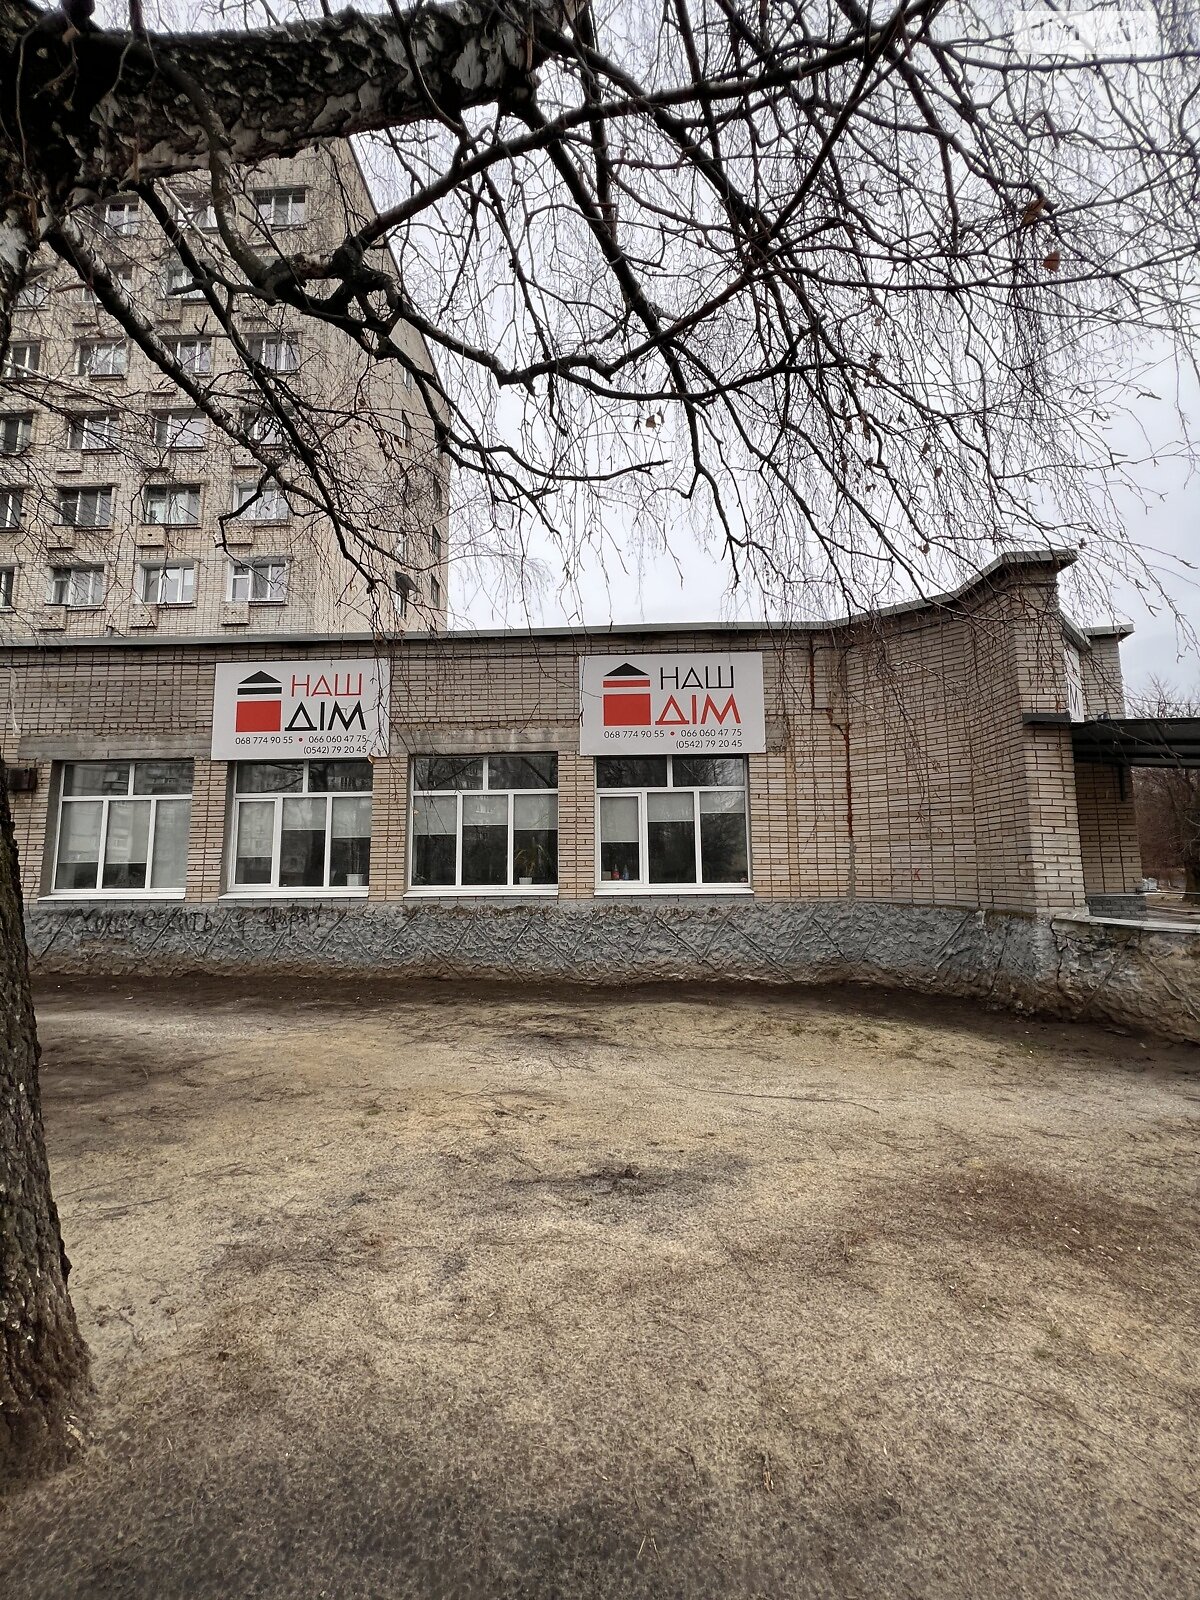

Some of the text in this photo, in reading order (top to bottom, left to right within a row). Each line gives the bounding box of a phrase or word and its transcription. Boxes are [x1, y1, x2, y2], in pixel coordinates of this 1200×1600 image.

[291, 673, 363, 697] НАШ
[660, 666, 734, 690] НАШ
[284, 700, 366, 731] ДІМ
[654, 693, 742, 725] ДІМ
[235, 737, 251, 745] 068
[253, 736, 268, 744] 774
[356, 734, 367, 742] 75
[604, 730, 620, 739] 068
[623, 730, 638, 738] 774
[681, 729, 697, 737] 066
[699, 729, 716, 737] 060
[717, 729, 730, 737] 47
[731, 728, 742, 736] 75
[303, 745, 367, 754] (0542) 79 20 45
[676, 740, 703, 749] (0542)
